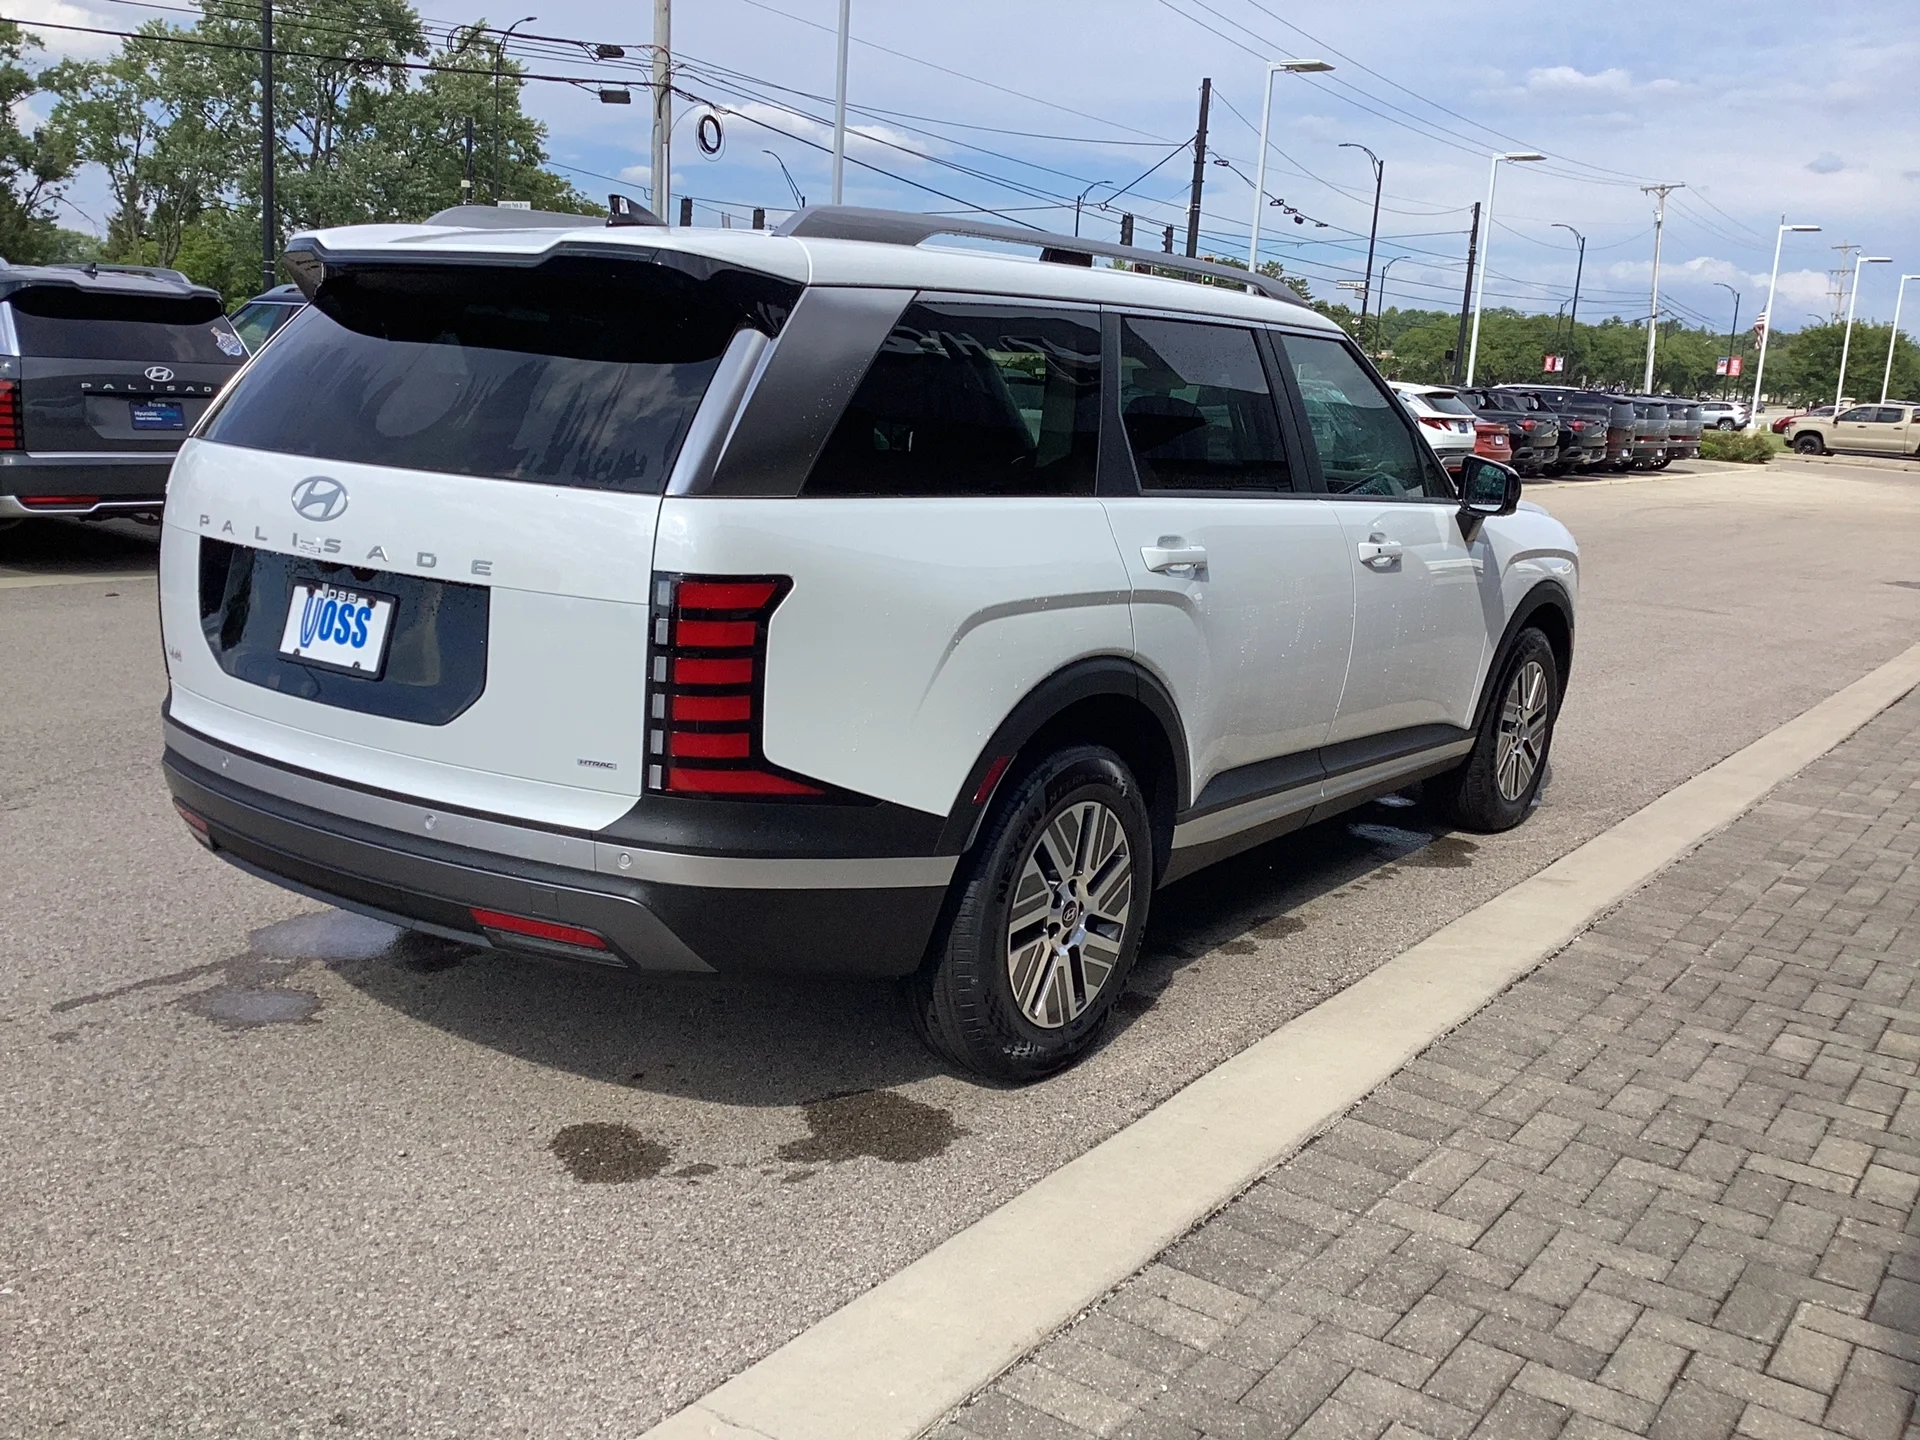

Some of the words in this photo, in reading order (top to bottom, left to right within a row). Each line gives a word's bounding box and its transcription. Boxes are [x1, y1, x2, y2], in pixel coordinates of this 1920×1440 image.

[81, 382, 213, 393] PALISAD
[199, 514, 494, 577] PALISADE
[299, 596, 372, 649] VOSS
[579, 759, 614, 770] HTRAC
[996, 806, 1043, 903] NEXEN
